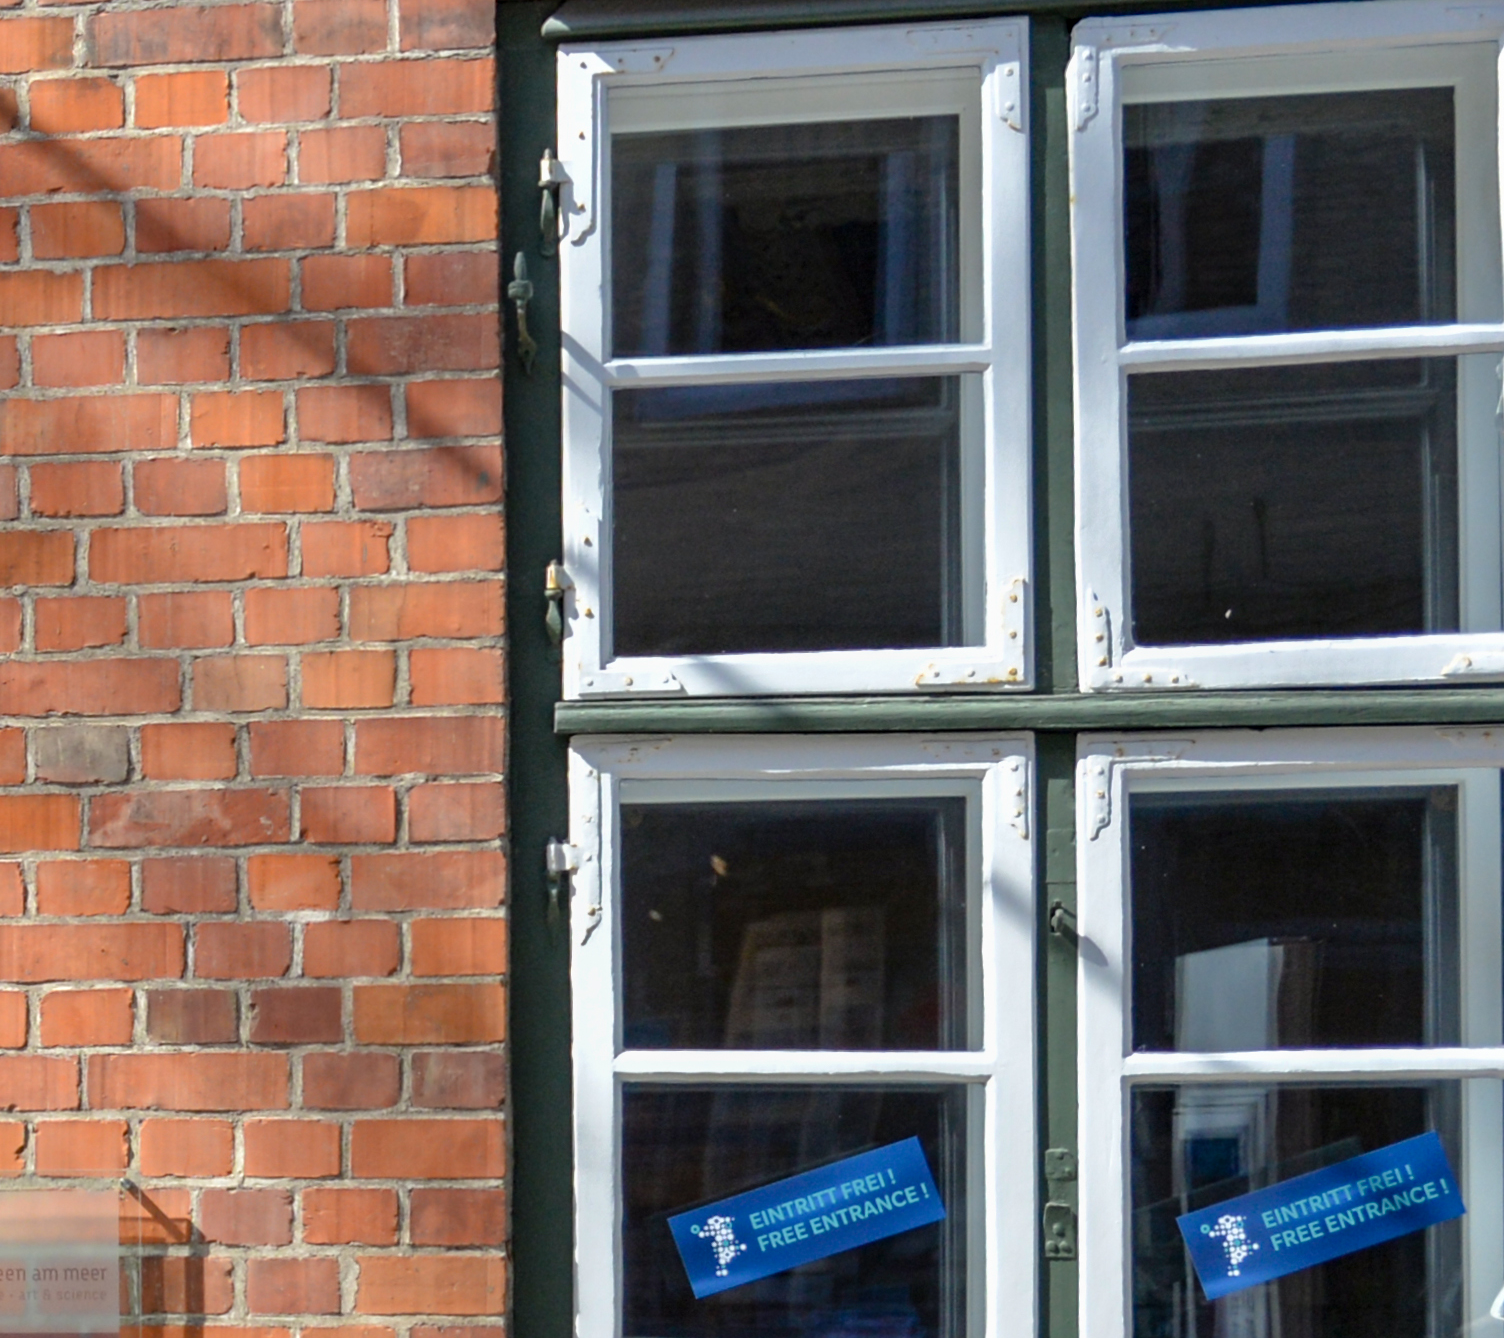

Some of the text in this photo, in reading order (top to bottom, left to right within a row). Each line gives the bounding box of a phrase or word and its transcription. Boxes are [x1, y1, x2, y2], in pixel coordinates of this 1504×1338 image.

[749, 1187, 837, 1230] EINTRITT
[1261, 1184, 1352, 1229] EINTRITT
[757, 1222, 808, 1252] FREE
[1269, 1220, 1324, 1251] FREE
[32, 1267, 59, 1282] am
[64, 1267, 107, 1282] meer
